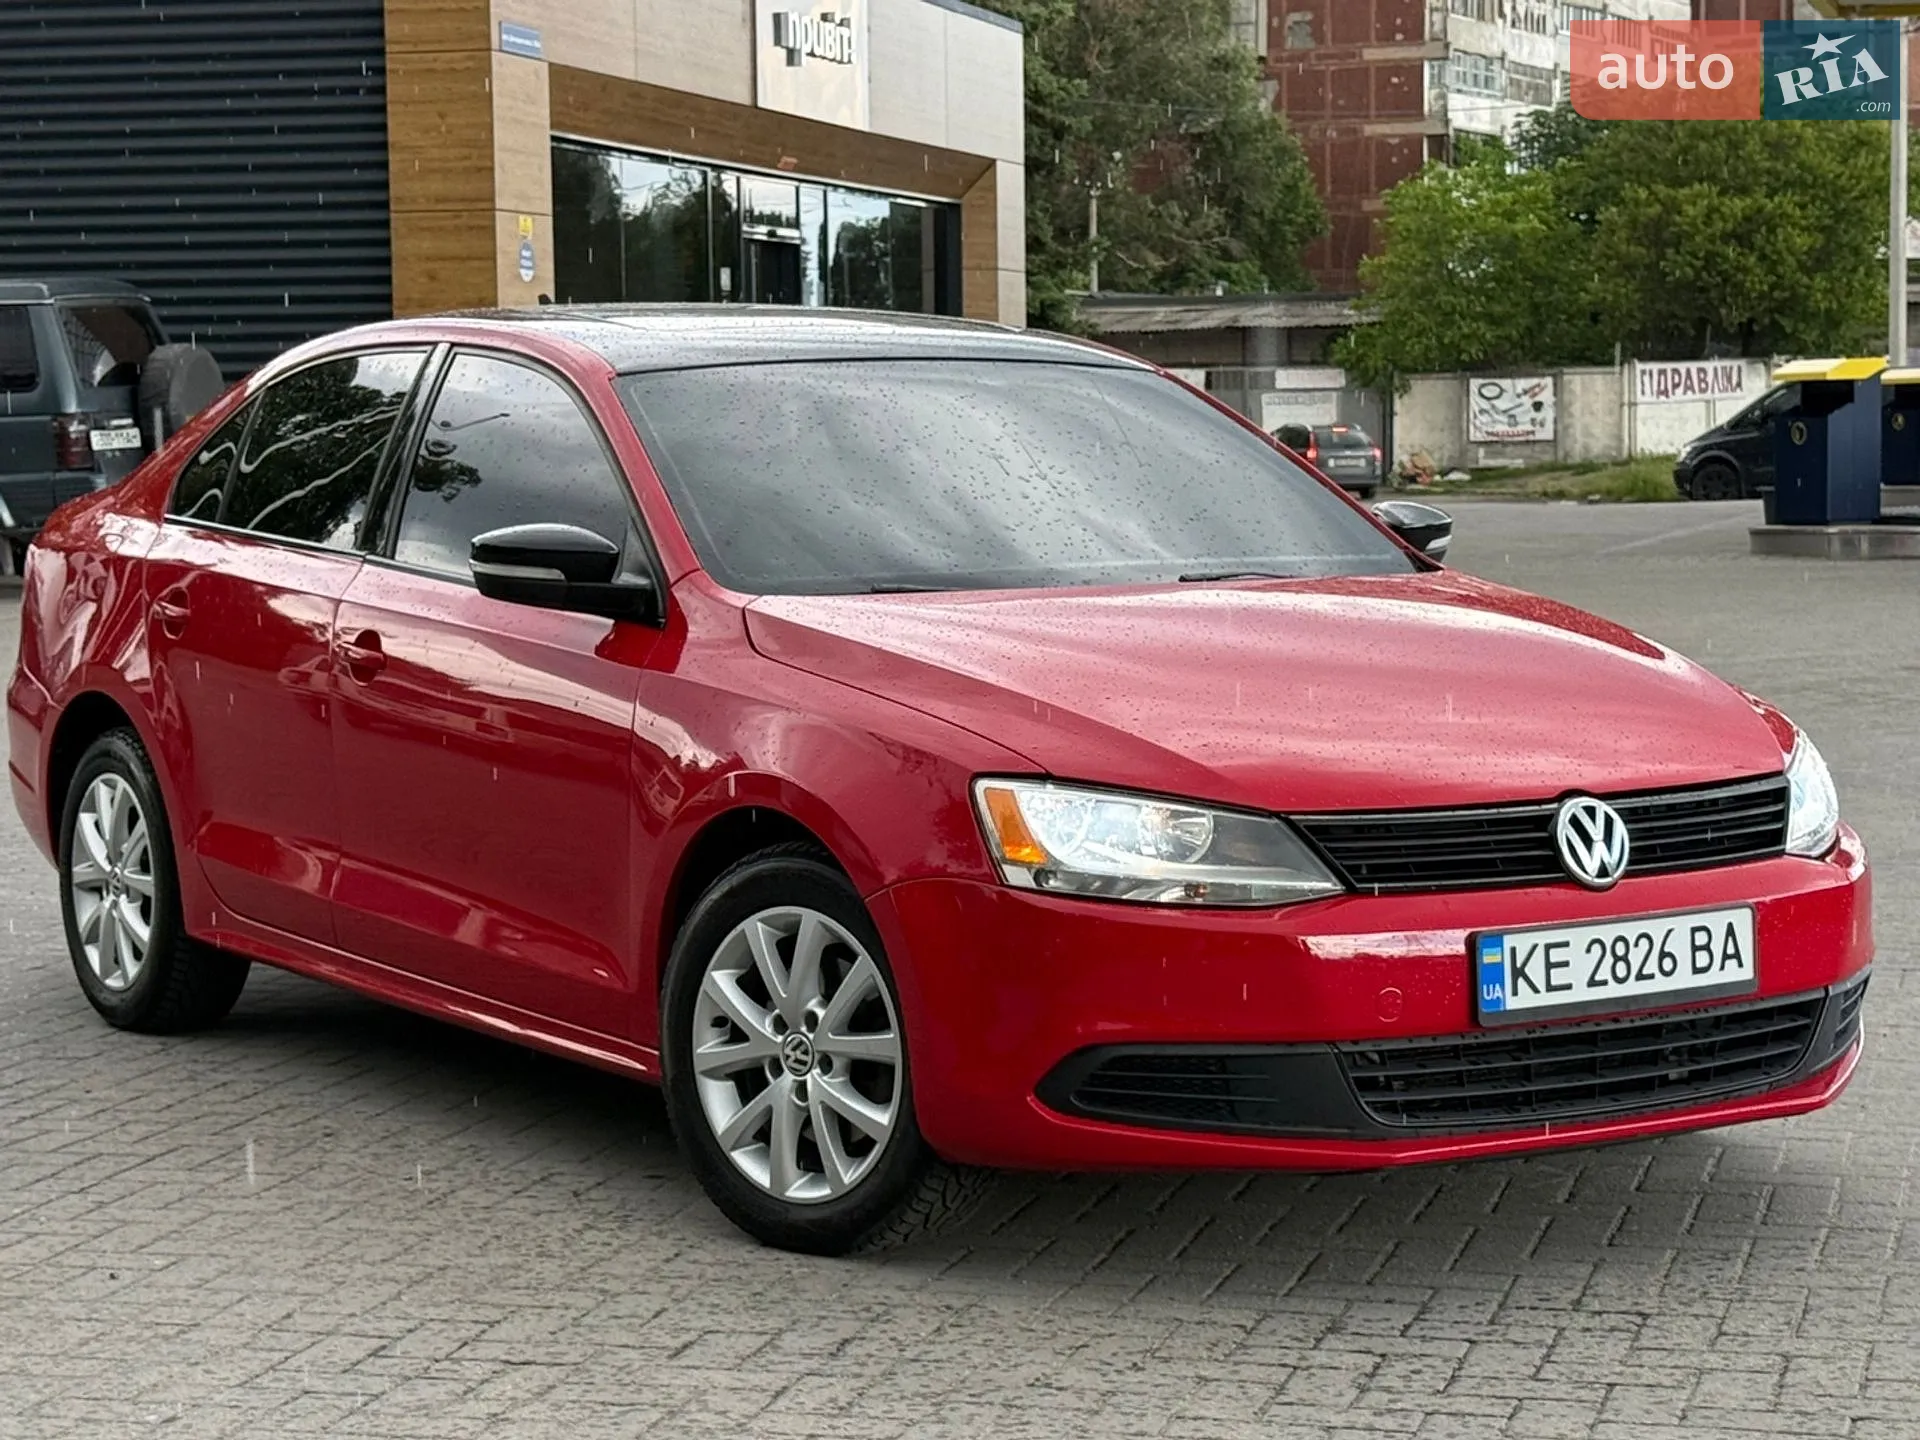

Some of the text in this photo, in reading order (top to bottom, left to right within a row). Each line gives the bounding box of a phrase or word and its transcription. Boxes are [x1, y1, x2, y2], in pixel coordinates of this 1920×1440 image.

[1640, 365, 1743, 399] ГІДРАВЛІКА
[1510, 921, 1744, 996] KE 2826 BA
[1483, 983, 1504, 1000] UA
